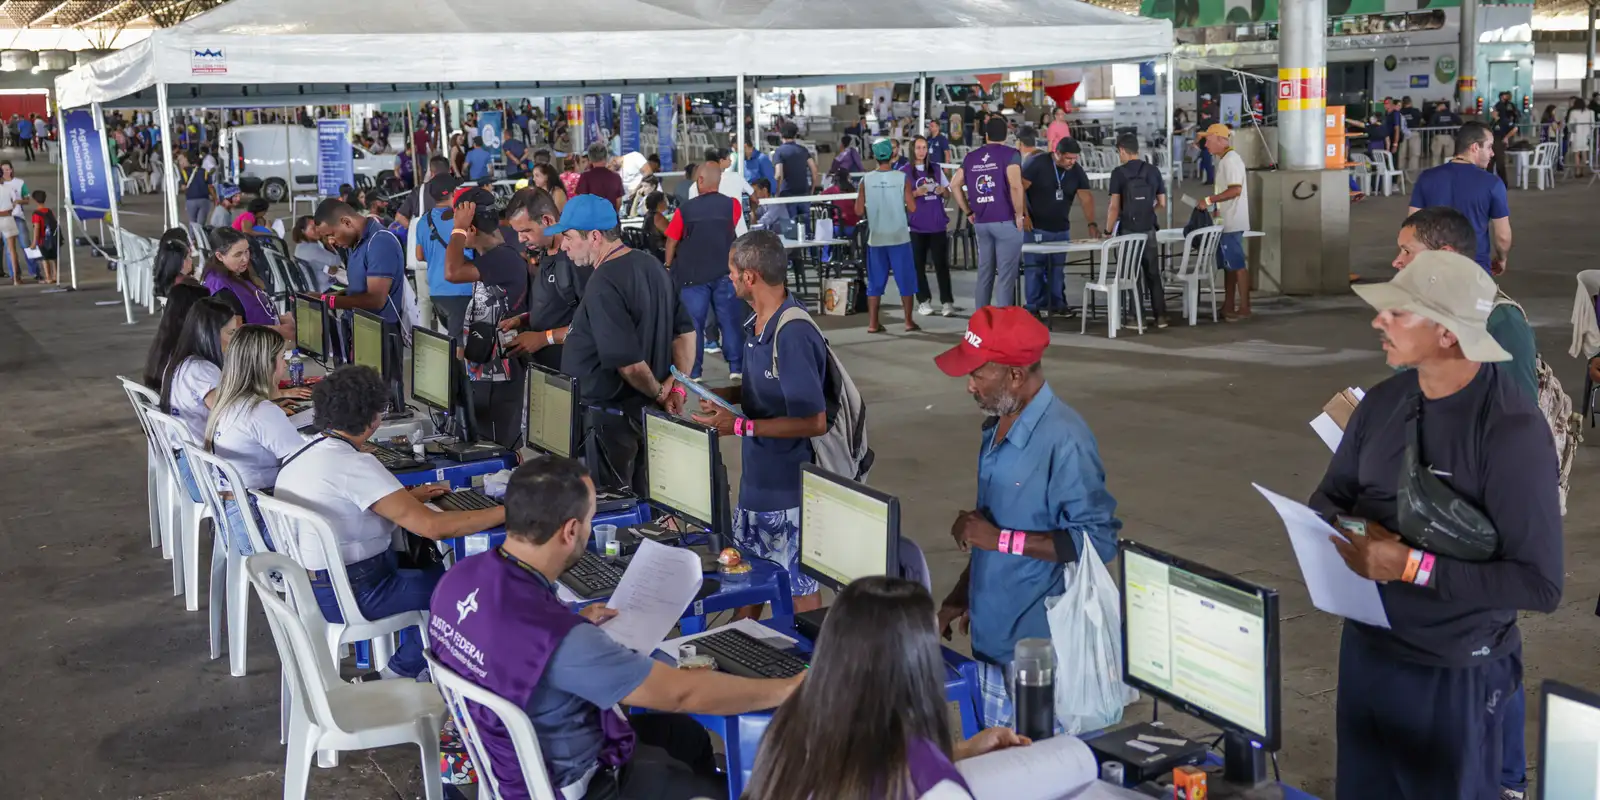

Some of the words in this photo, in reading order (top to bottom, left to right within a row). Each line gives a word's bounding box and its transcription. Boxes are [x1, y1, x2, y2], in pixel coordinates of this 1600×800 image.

[69, 128, 86, 193] Trabalhador
[78, 127, 94, 171] Agência
[86, 172, 96, 186] do
[976, 195, 995, 204] CAIXA
[431, 614, 454, 638] JUSTIÇA
[453, 631, 485, 666] FEDERAL
